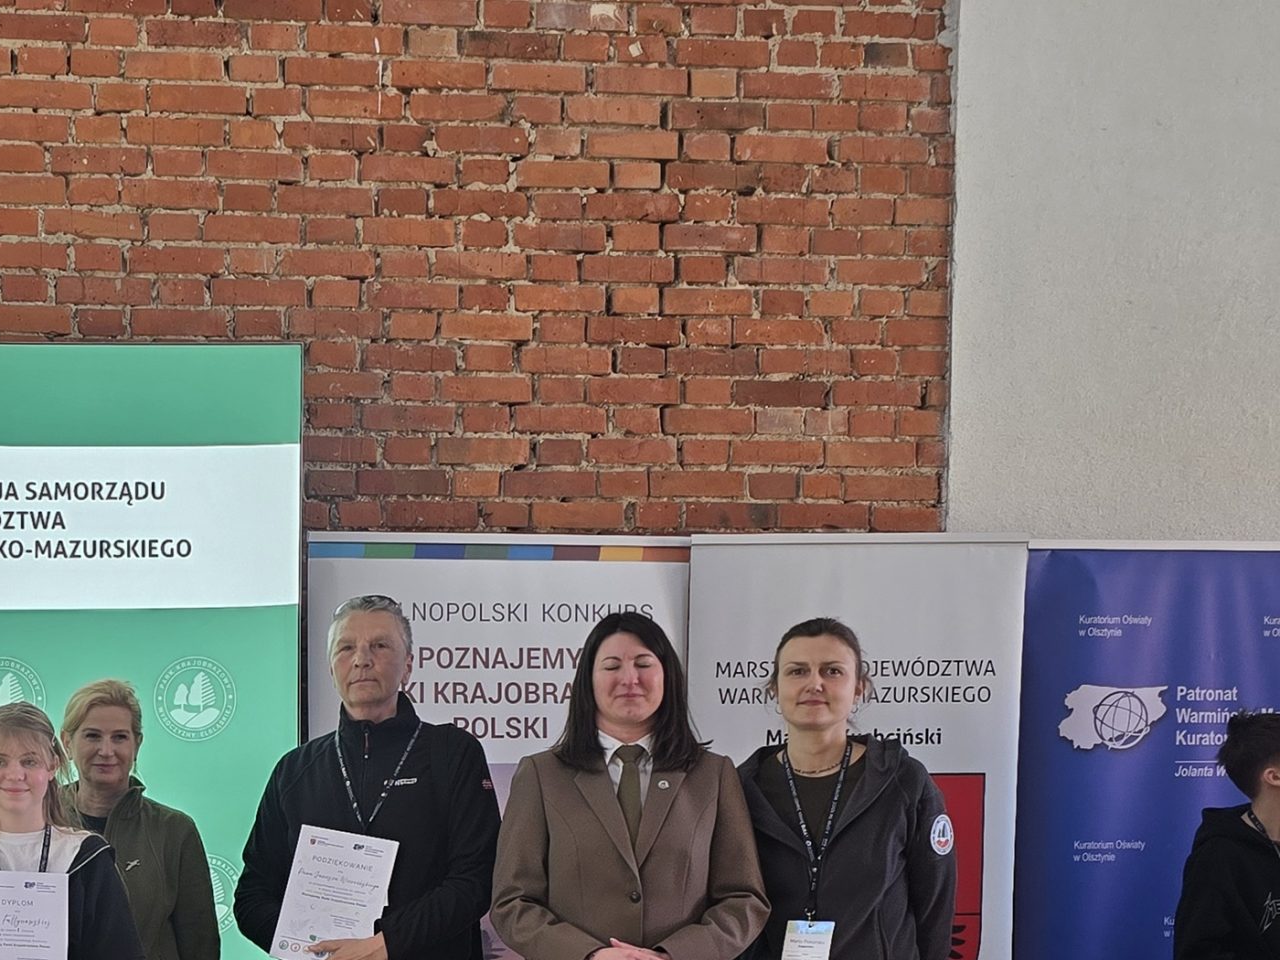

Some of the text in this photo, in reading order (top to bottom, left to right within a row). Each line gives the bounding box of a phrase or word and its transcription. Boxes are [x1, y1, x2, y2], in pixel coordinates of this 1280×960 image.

[25, 481, 166, 507] SAMORZĄDU
[411, 602, 528, 622] NOPOLSKI
[1078, 614, 1153, 627] Kuratorium Oświaty
[1263, 616, 1280, 625] Kura
[1087, 627, 1122, 639] Olsztynie
[418, 646, 584, 669] POZNAJEMY
[433, 682, 573, 704] KRAJOBRA
[718, 686, 992, 705] WARM AZURSKIEGO
[1176, 686, 1238, 701] Patronat
[1175, 708, 1238, 723] Warmiń
[1174, 765, 1227, 777] Jolanta W
[1073, 841, 1114, 850] Kuratorium
[1081, 852, 1116, 864] Olsztynie
